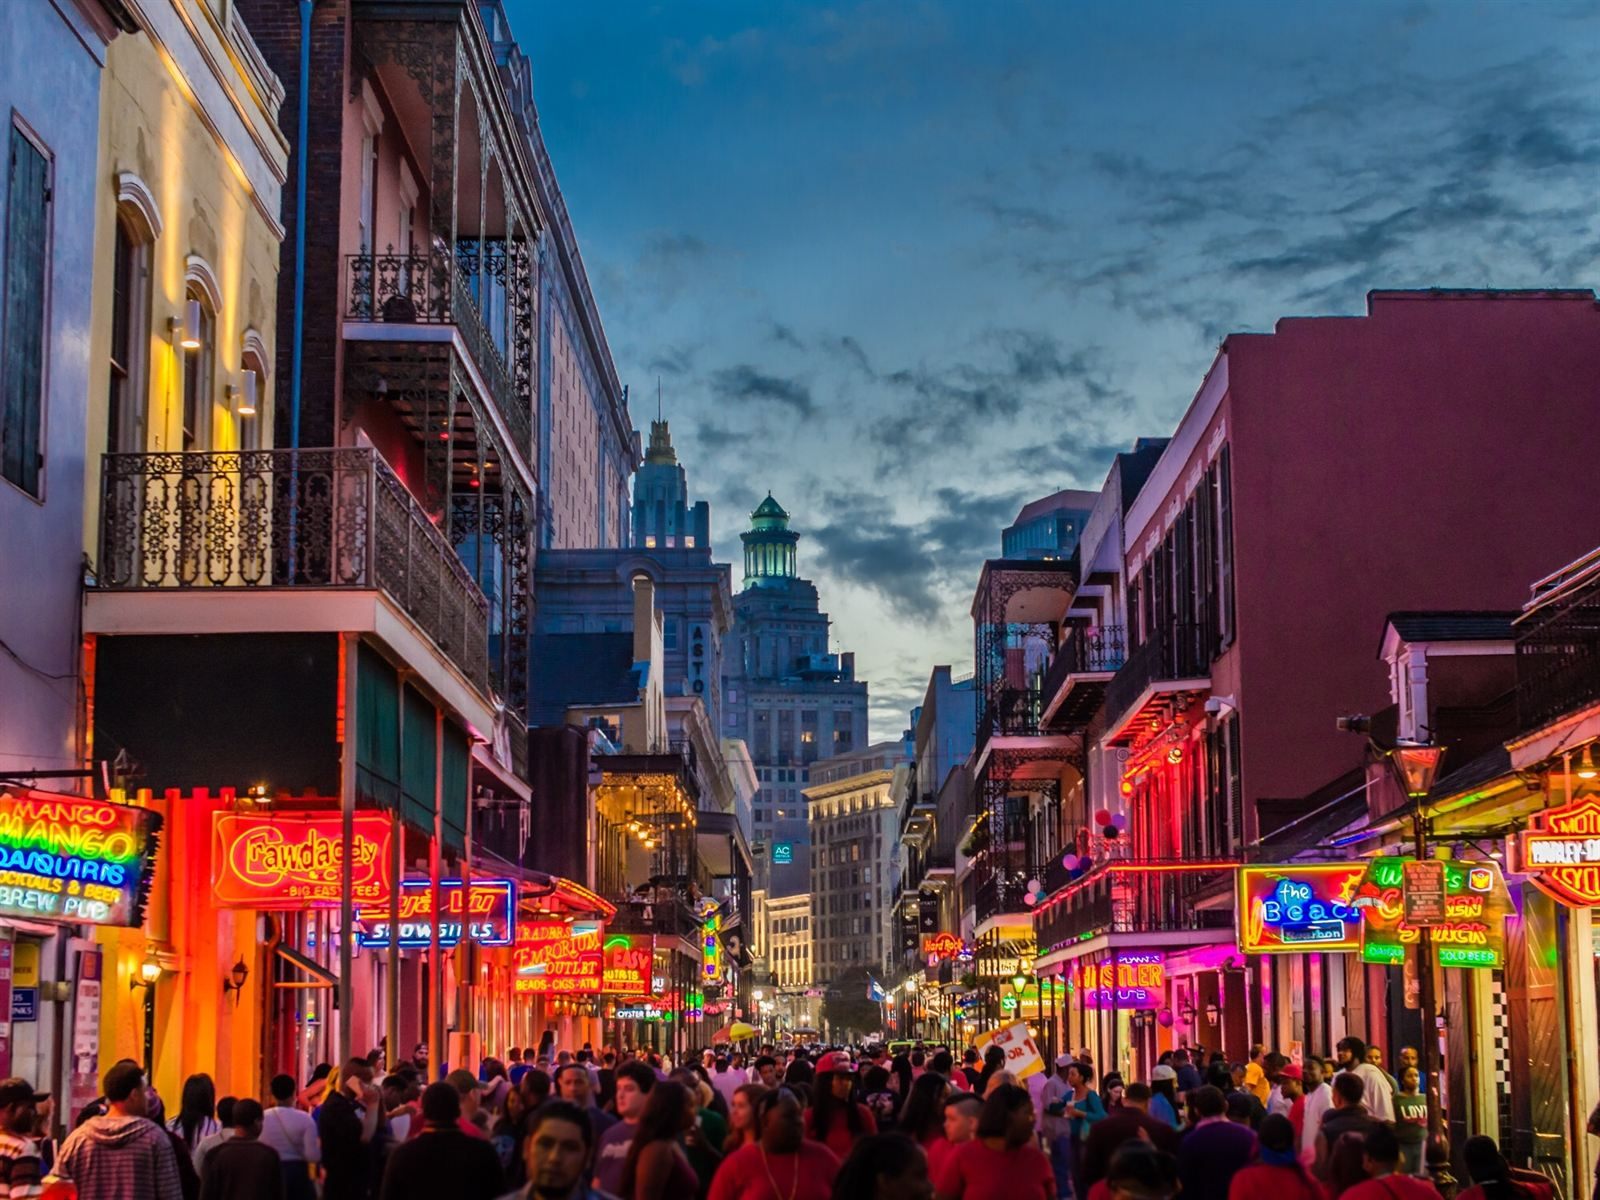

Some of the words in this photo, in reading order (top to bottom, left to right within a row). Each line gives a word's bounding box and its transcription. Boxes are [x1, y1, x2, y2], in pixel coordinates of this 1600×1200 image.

[13, 802, 116, 825] MANGO
[0, 812, 135, 863] MANGO
[68, 880, 80, 895] &
[84, 883, 121, 902] BEER
[314, 886, 342, 896] EAS
[1280, 884, 1309, 904] the
[64, 897, 109, 920] PUB
[517, 925, 571, 940] TRADERS
[514, 930, 600, 968] EMPORIUM
[925, 940, 942, 952] Hard
[945, 938, 962, 952] Rock
[545, 961, 598, 975] OUTLET
[613, 950, 649, 969] EASY
[516, 979, 547, 990] BEADS
[552, 978, 575, 989] CIGS
[581, 978, 599, 989] ATM
[618, 1010, 644, 1018] OYSTER
[646, 1010, 661, 1018] BAR
